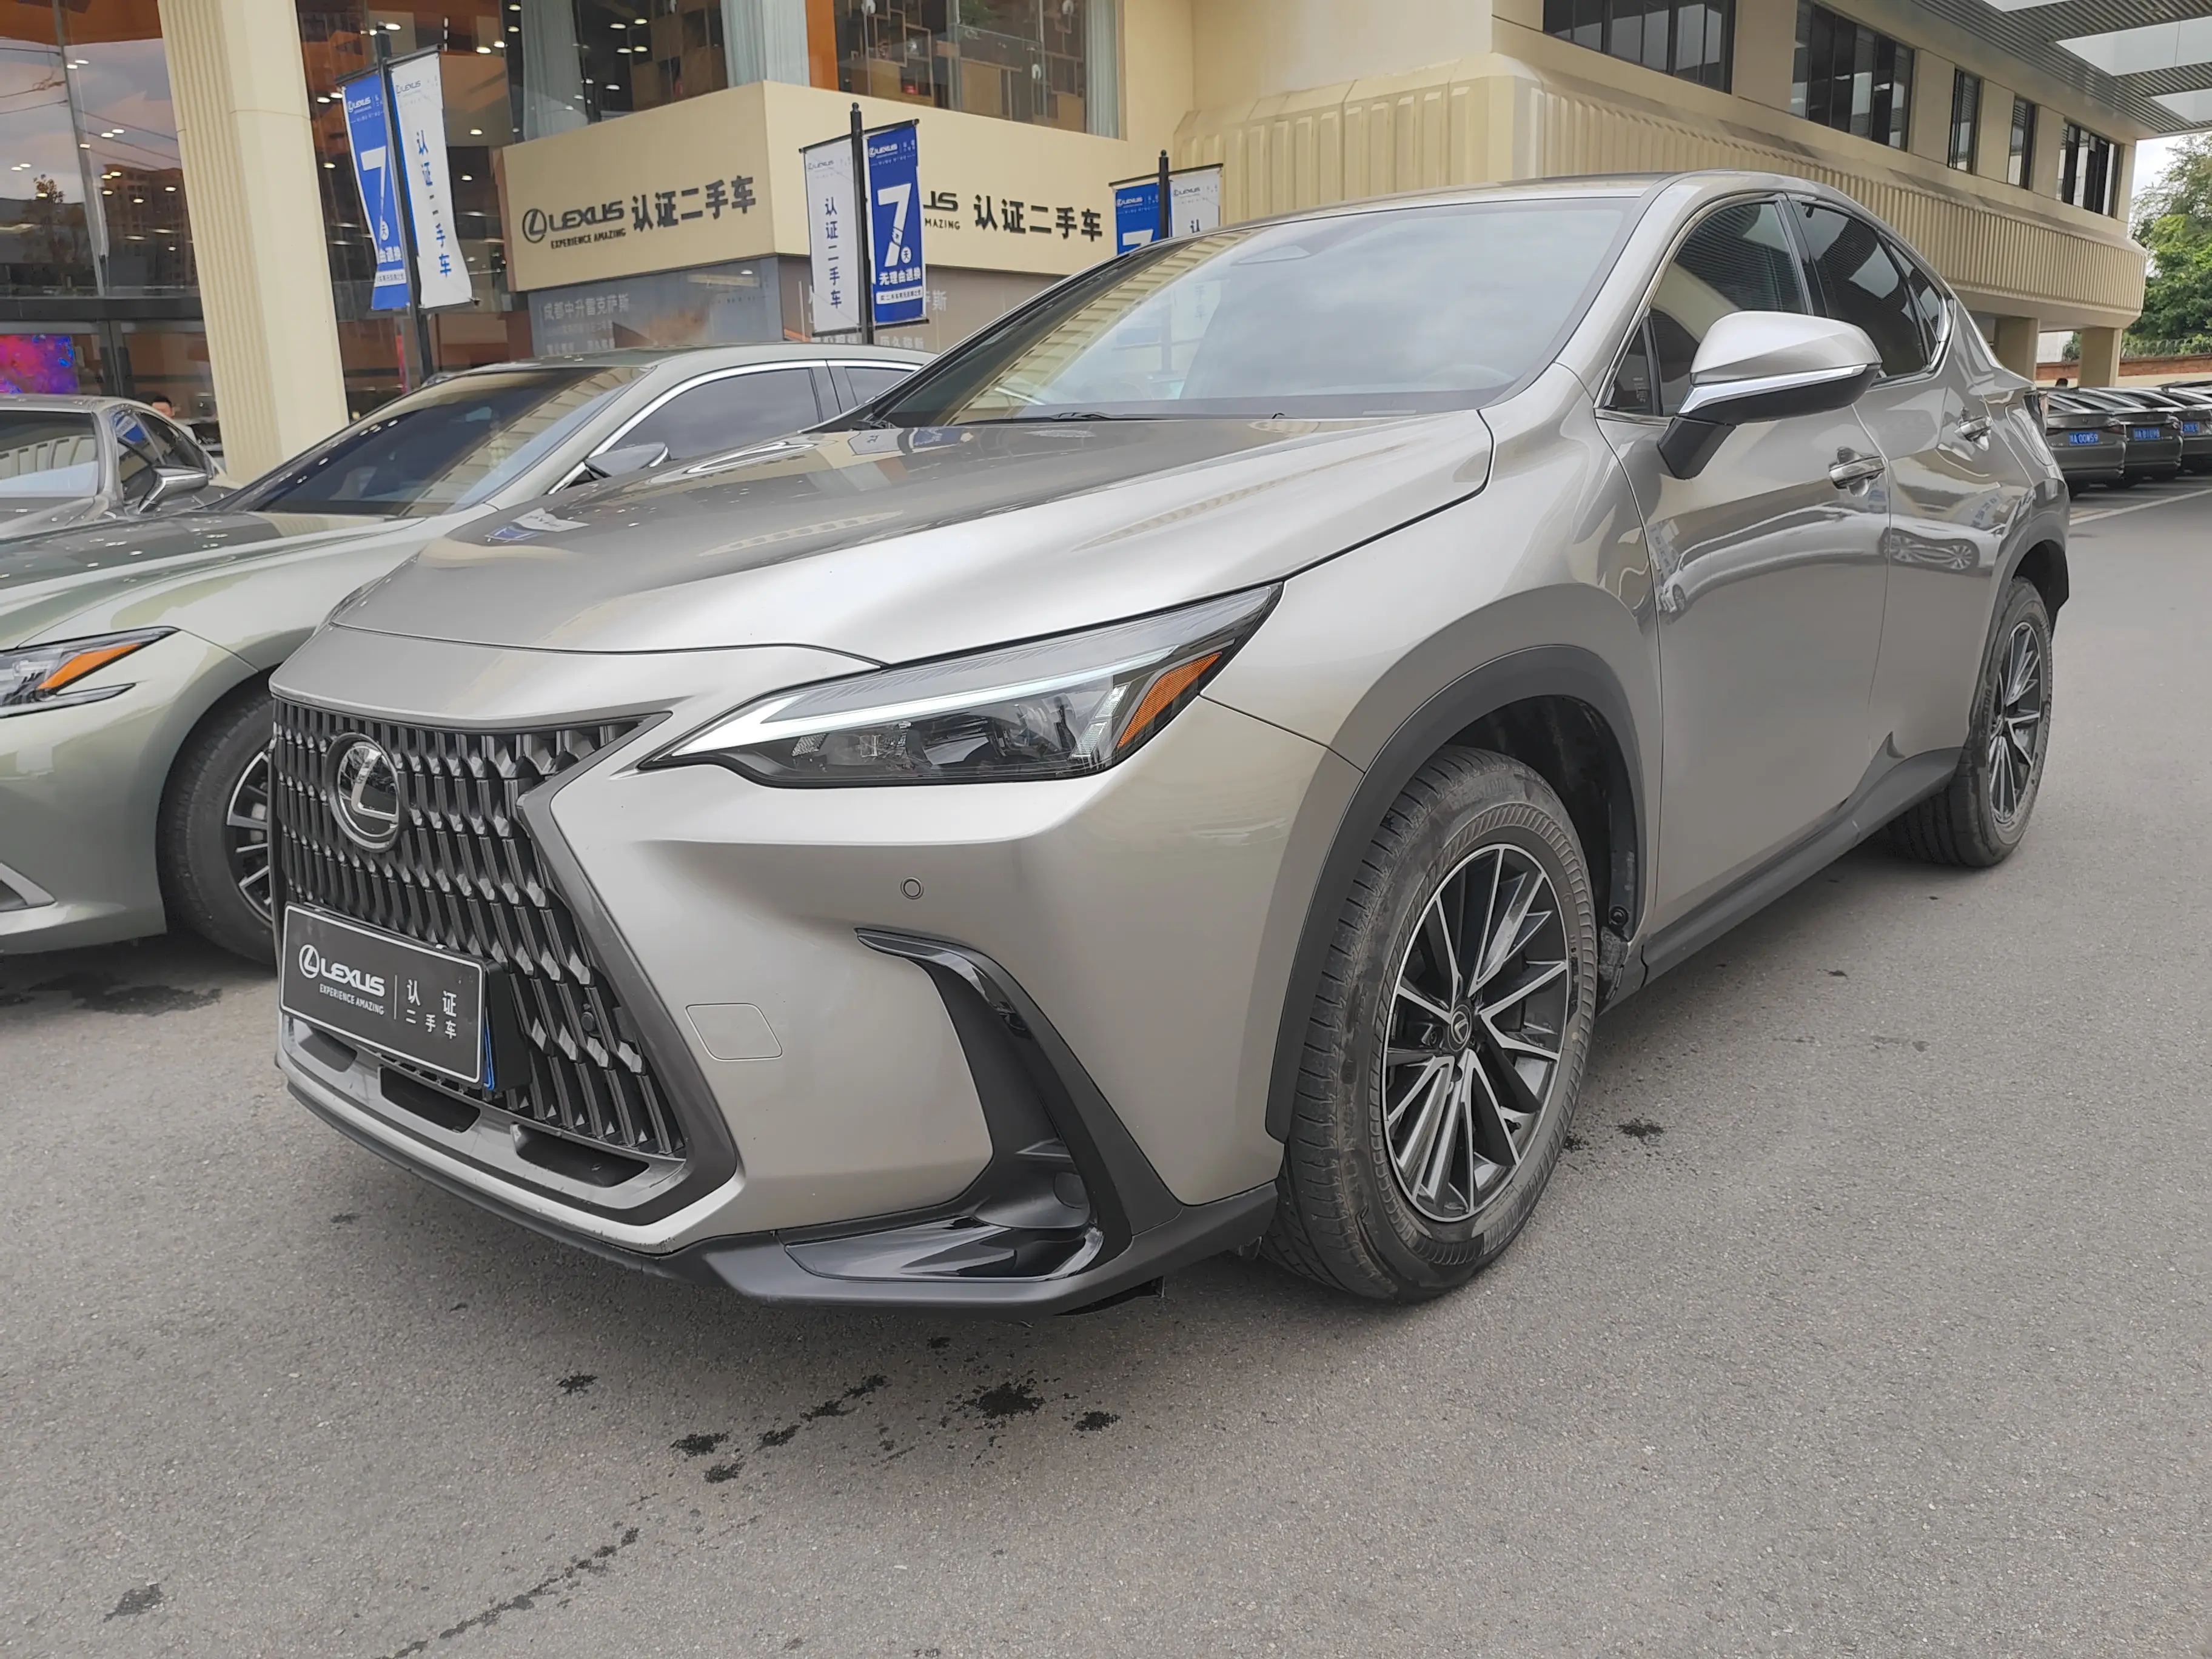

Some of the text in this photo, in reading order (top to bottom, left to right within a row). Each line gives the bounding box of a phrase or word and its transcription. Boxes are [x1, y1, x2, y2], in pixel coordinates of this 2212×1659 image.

[417, 129, 452, 277] 认证二手车
[549, 201, 625, 232] LEXUS
[632, 175, 756, 232] 认证二手车
[925, 218, 960, 230] MAZING
[974, 195, 1102, 241] 认证二手车
[551, 228, 626, 249] EXPERIENCE AMAZING
[877, 183, 911, 267] 7
[825, 197, 842, 308] 认证二手车
[320, 958, 384, 997] LEXUS
[319, 983, 385, 1015] EXPERIENCE AMAZING
